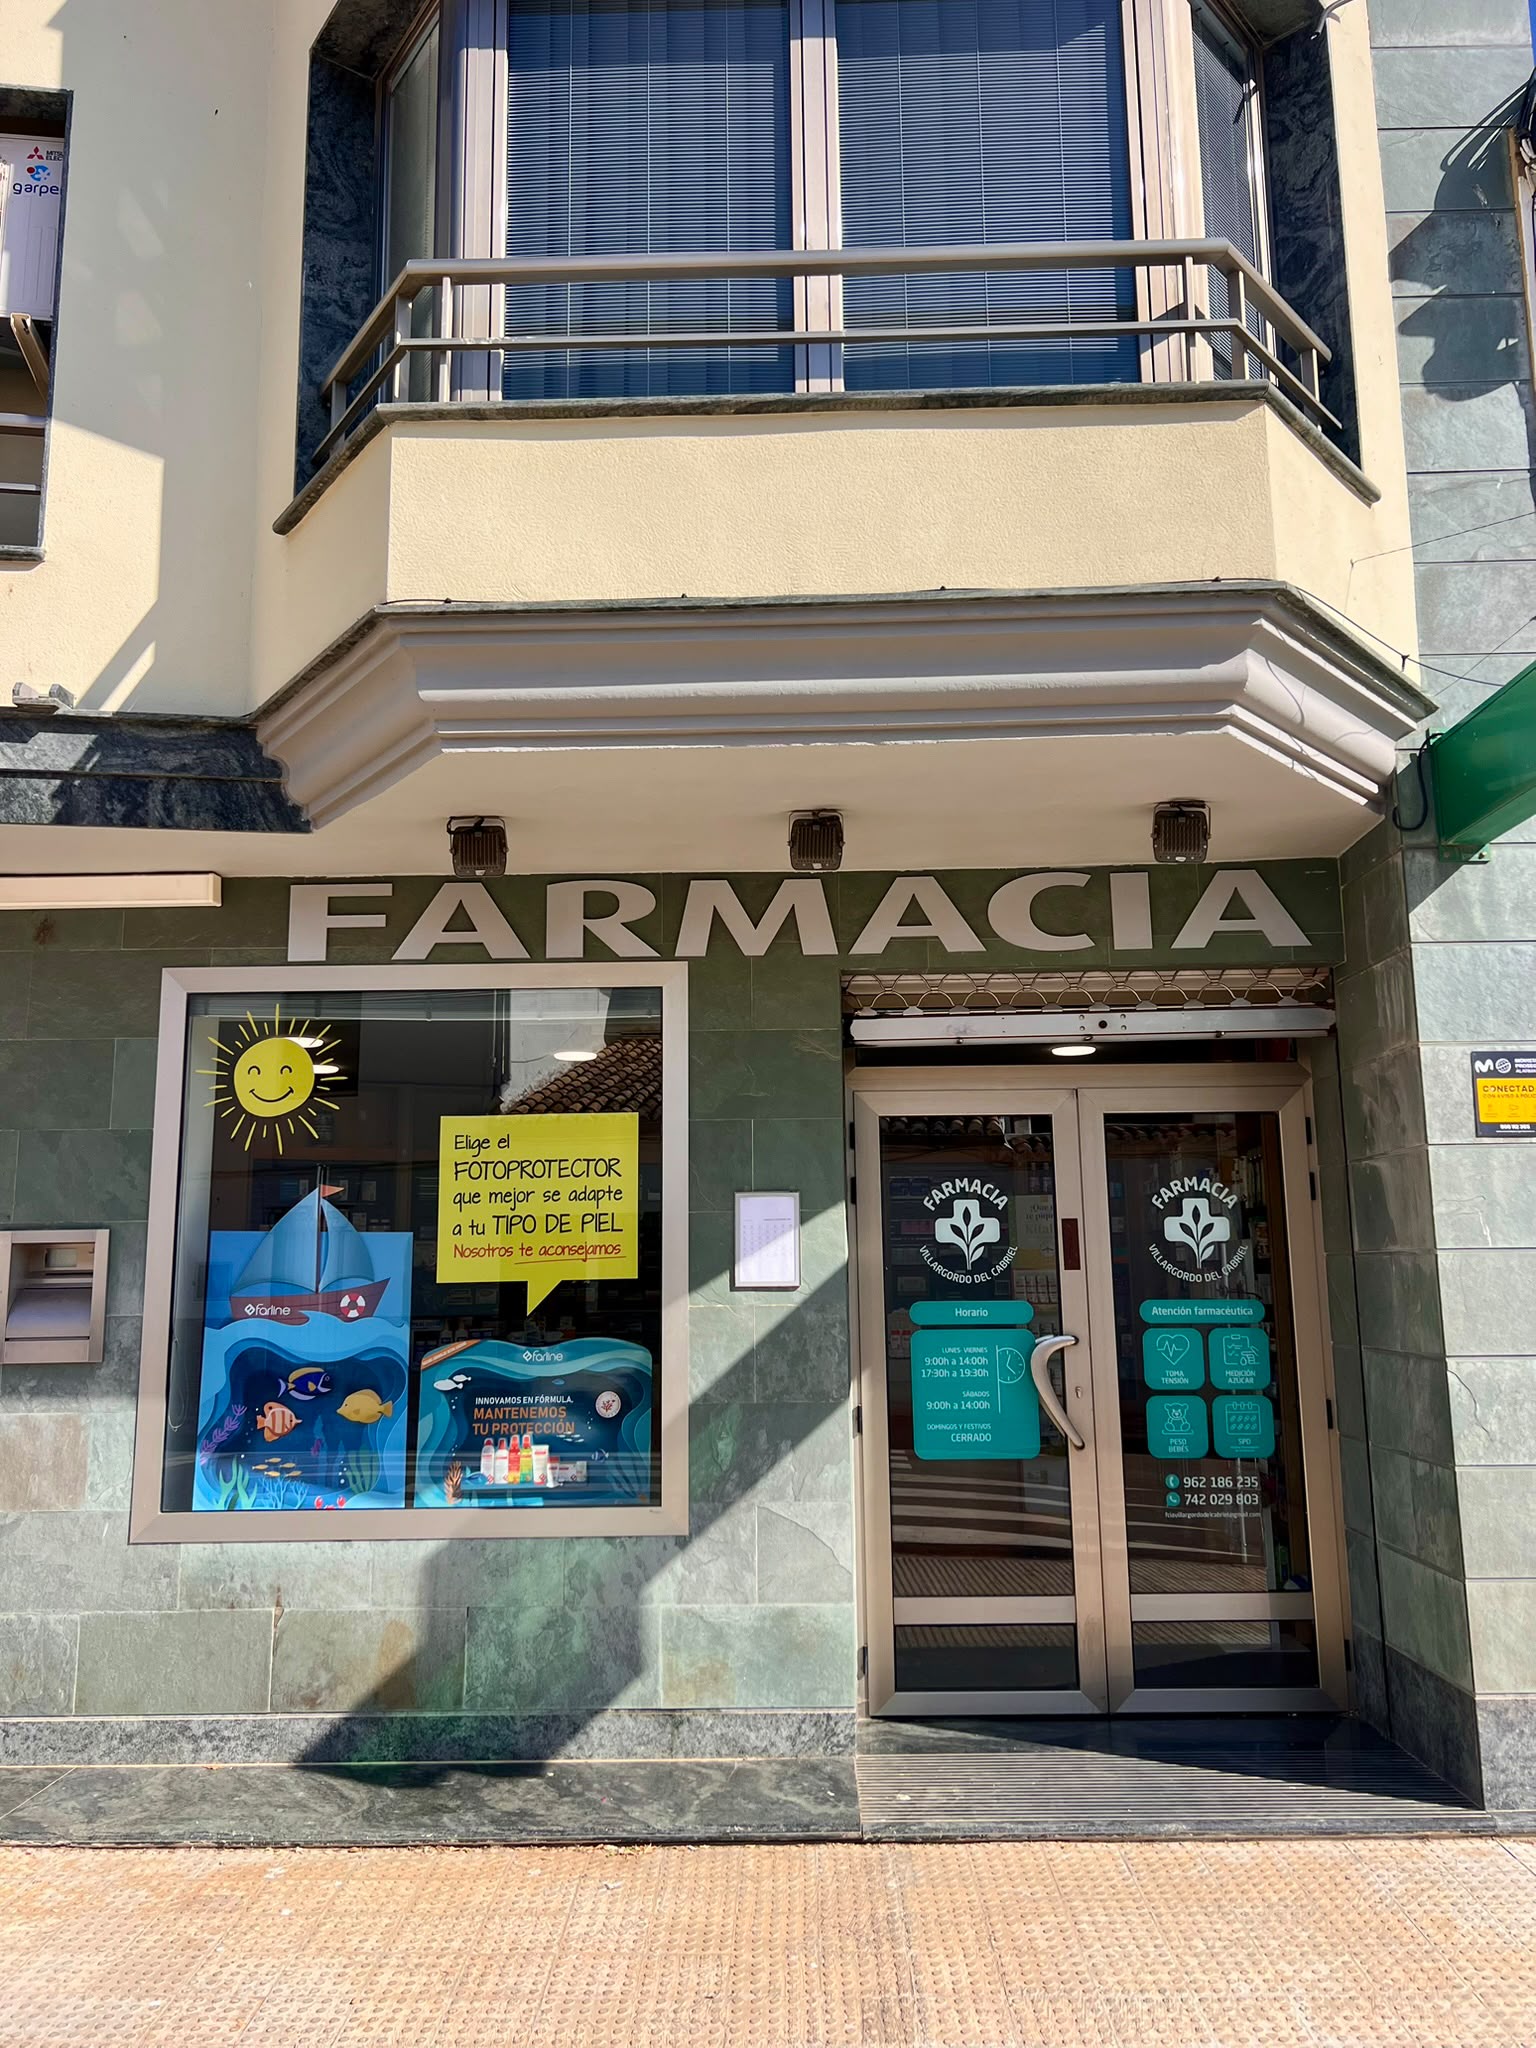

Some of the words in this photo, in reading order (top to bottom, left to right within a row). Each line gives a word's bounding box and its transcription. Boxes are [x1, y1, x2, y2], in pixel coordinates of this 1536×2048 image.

[13, 183, 61, 197] garpe
[287, 869, 1312, 961] FARMACIA
[1482, 1085, 1536, 1093] CONECTAD
[454, 1134, 491, 1157] Elige
[497, 1134, 510, 1149] el
[454, 1158, 622, 1181] FOTOPROTECTOR
[453, 1191, 481, 1212] que
[488, 1188, 535, 1211] mejor
[543, 1190, 561, 1202] se
[568, 1185, 623, 1209] adapte
[923, 1178, 1008, 1211] FARMACIA
[1151, 1176, 1238, 1210] FARMACIA
[452, 1223, 462, 1236] a
[469, 1220, 485, 1235] tu
[492, 1214, 537, 1235] TIPO
[545, 1213, 572, 1234] DE
[581, 1212, 623, 1233] PIEL
[453, 1243, 513, 1258] Nosotros
[519, 1243, 533, 1257] te
[539, 1241, 621, 1262] aconsejamos
[919, 1245, 972, 1284] VILLARGORDO
[974, 1272, 991, 1283] DEL
[991, 1245, 1018, 1276] CABRIEL
[1148, 1243, 1202, 1283] VILLARGORDO
[1204, 1271, 1222, 1282] DEL
[1221, 1244, 1249, 1276] CABRIEL
[255, 1304, 291, 1316] farline
[955, 1307, 988, 1317] Horario
[1151, 1306, 1192, 1316] Atención
[1194, 1305, 1253, 1316] farmacéutica
[532, 1350, 564, 1362] farline
[924, 1357, 949, 1365] 9:00h
[959, 1356, 988, 1365] 14:00h
[921, 1369, 950, 1378] 17:30h
[960, 1368, 989, 1377] 19:30h
[475, 1396, 522, 1405] INNOVAMOS
[522, 1396, 534, 1404] EN
[926, 1402, 951, 1410] 9:00h
[960, 1401, 990, 1410] 14:00h
[474, 1406, 567, 1420] MANTENEMOS
[472, 1423, 489, 1435] TU
[492, 1418, 575, 1435] PROTECCIÓN
[951, 1433, 992, 1442] CERRADO
[1183, 1476, 1206, 1488] 962
[1210, 1476, 1233, 1488] 186
[1236, 1476, 1258, 1488] 235
[1184, 1493, 1206, 1505] 742
[1210, 1493, 1232, 1505] 029
[1236, 1493, 1258, 1505] 803
